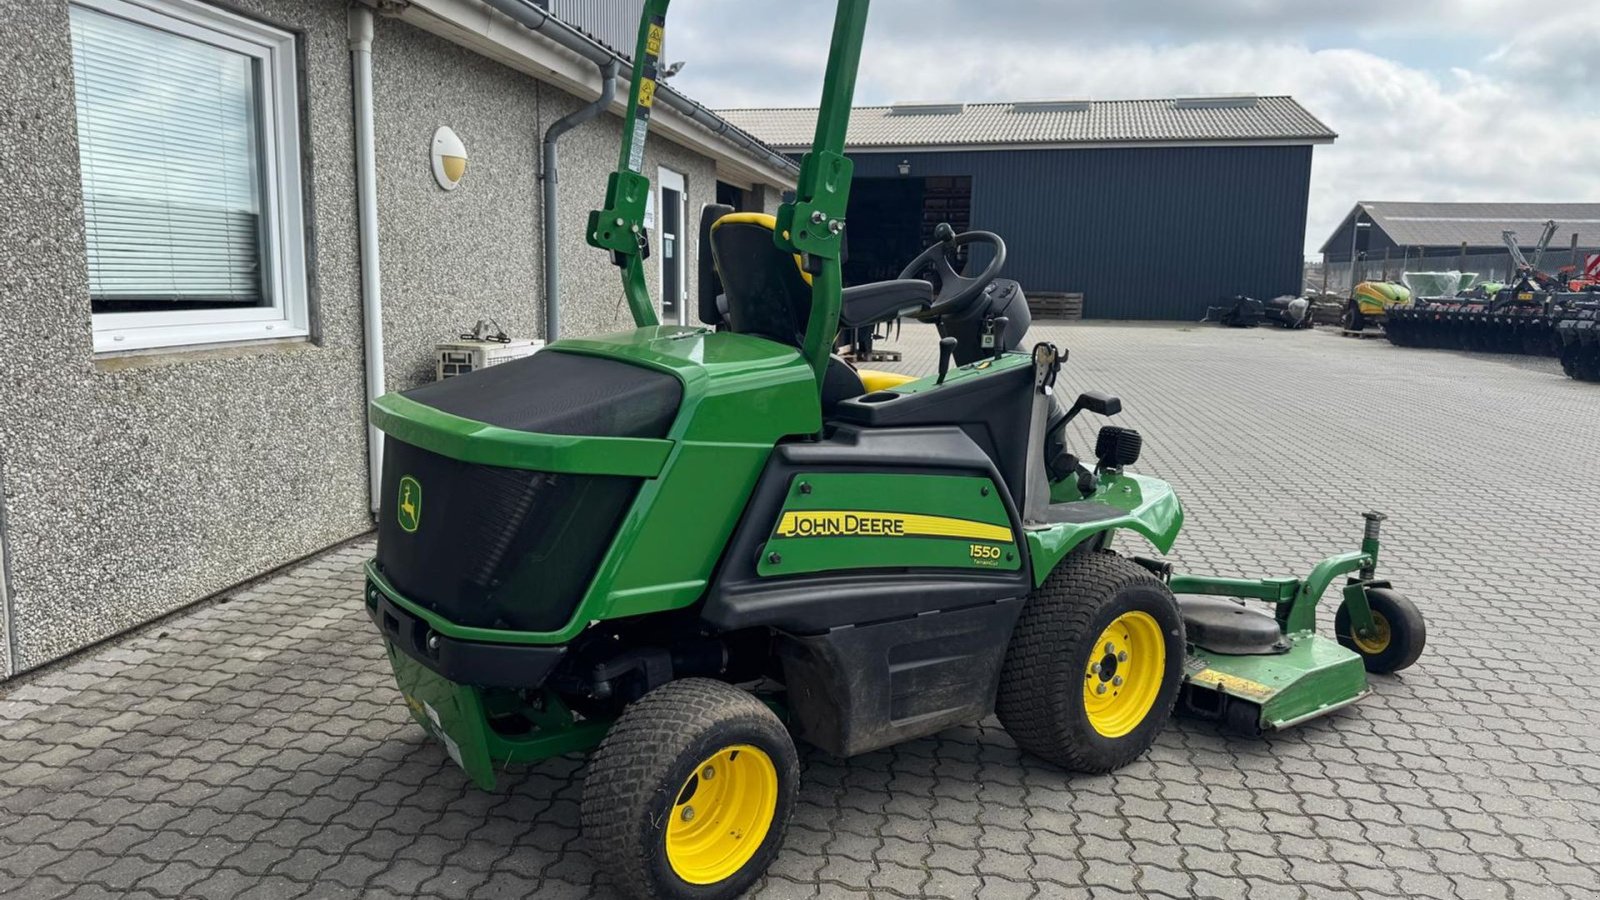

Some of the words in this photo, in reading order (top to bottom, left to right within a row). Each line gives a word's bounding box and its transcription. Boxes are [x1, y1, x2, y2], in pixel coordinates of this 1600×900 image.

[787, 516, 840, 534] JOHN
[844, 515, 904, 533] DEERE
[969, 544, 1001, 559] 1550
